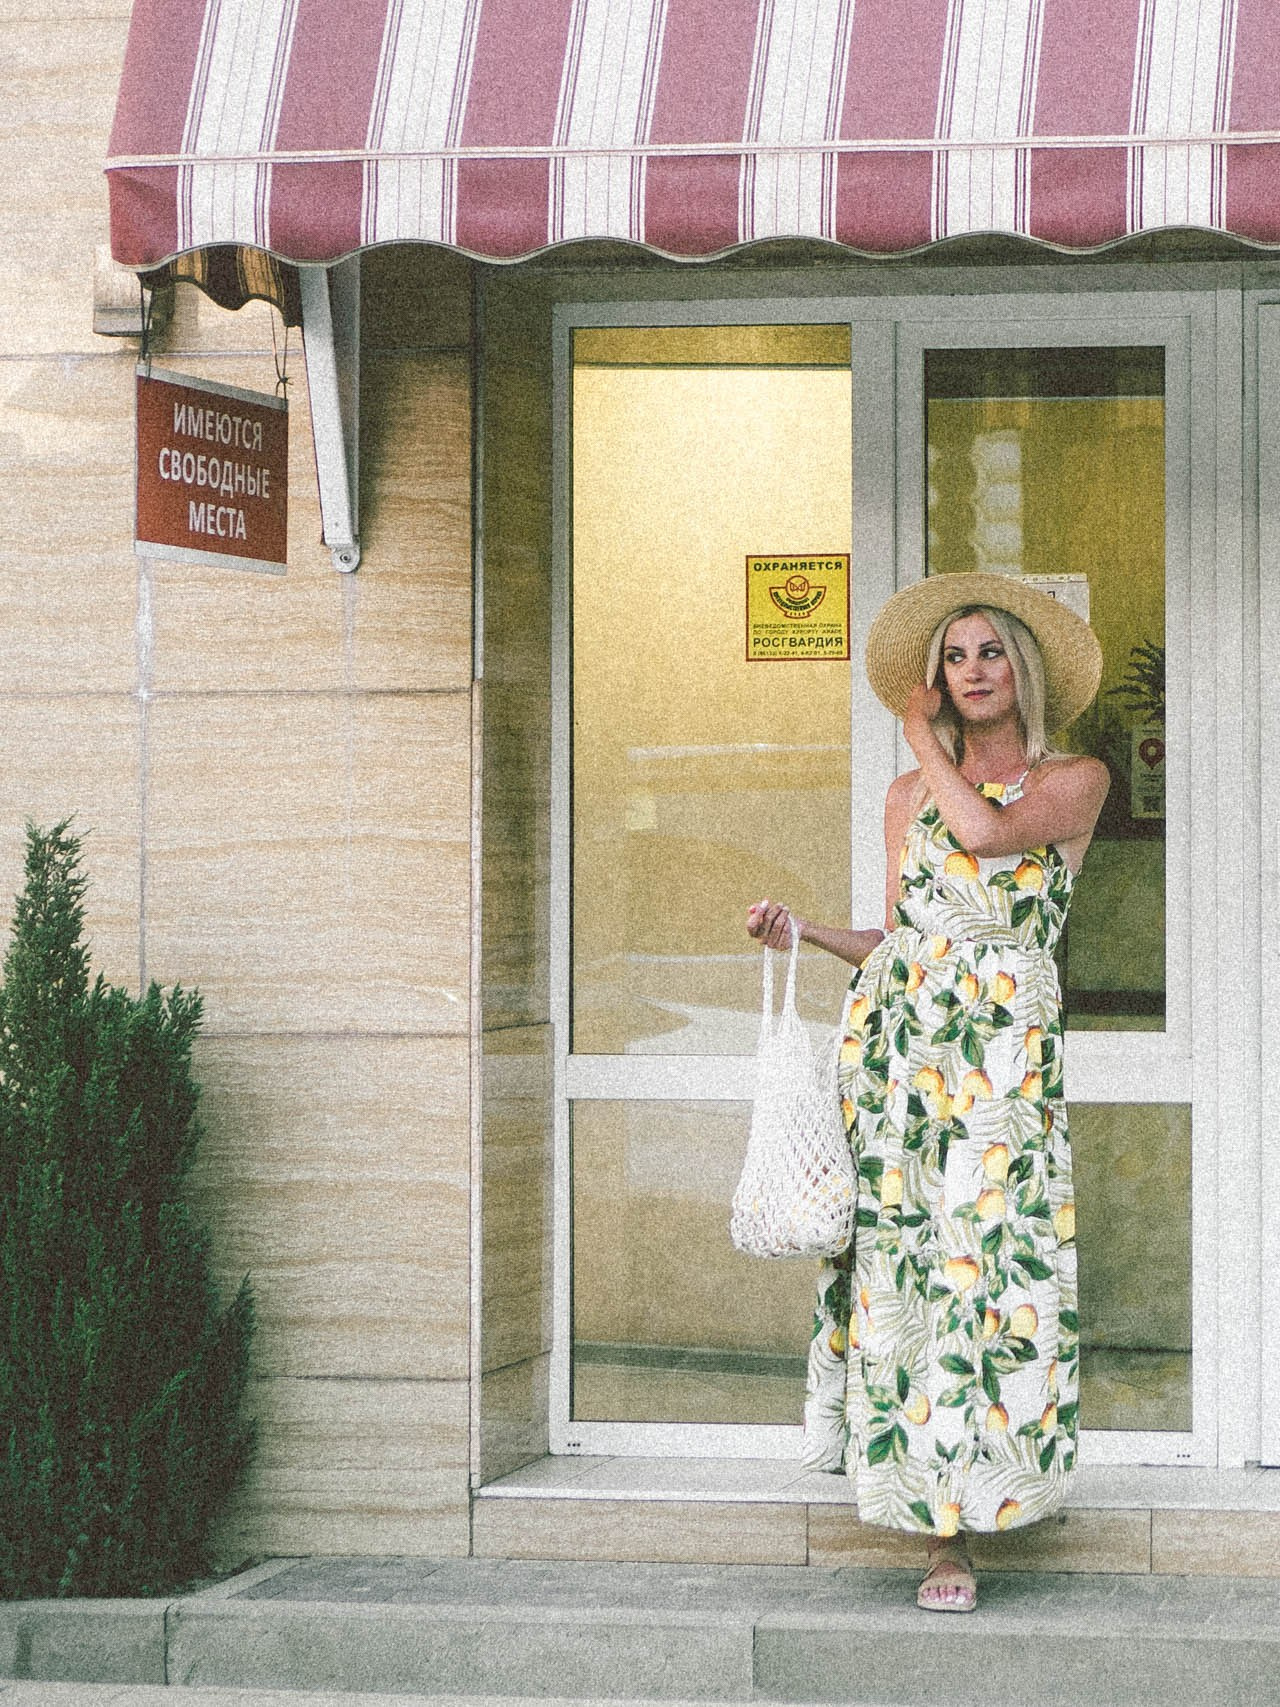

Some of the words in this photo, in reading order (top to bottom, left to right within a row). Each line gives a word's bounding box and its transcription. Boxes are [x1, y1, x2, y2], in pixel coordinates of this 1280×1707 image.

[173, 402, 263, 451] ИМЕЮТСЯ
[158, 447, 271, 498] СВОБОДНЫЕ
[188, 500, 247, 540] МЕСТА
[753, 561, 843, 572] ОХРАНЯЕТСЯ
[753, 637, 843, 648] РОСГВАРДИЯ
